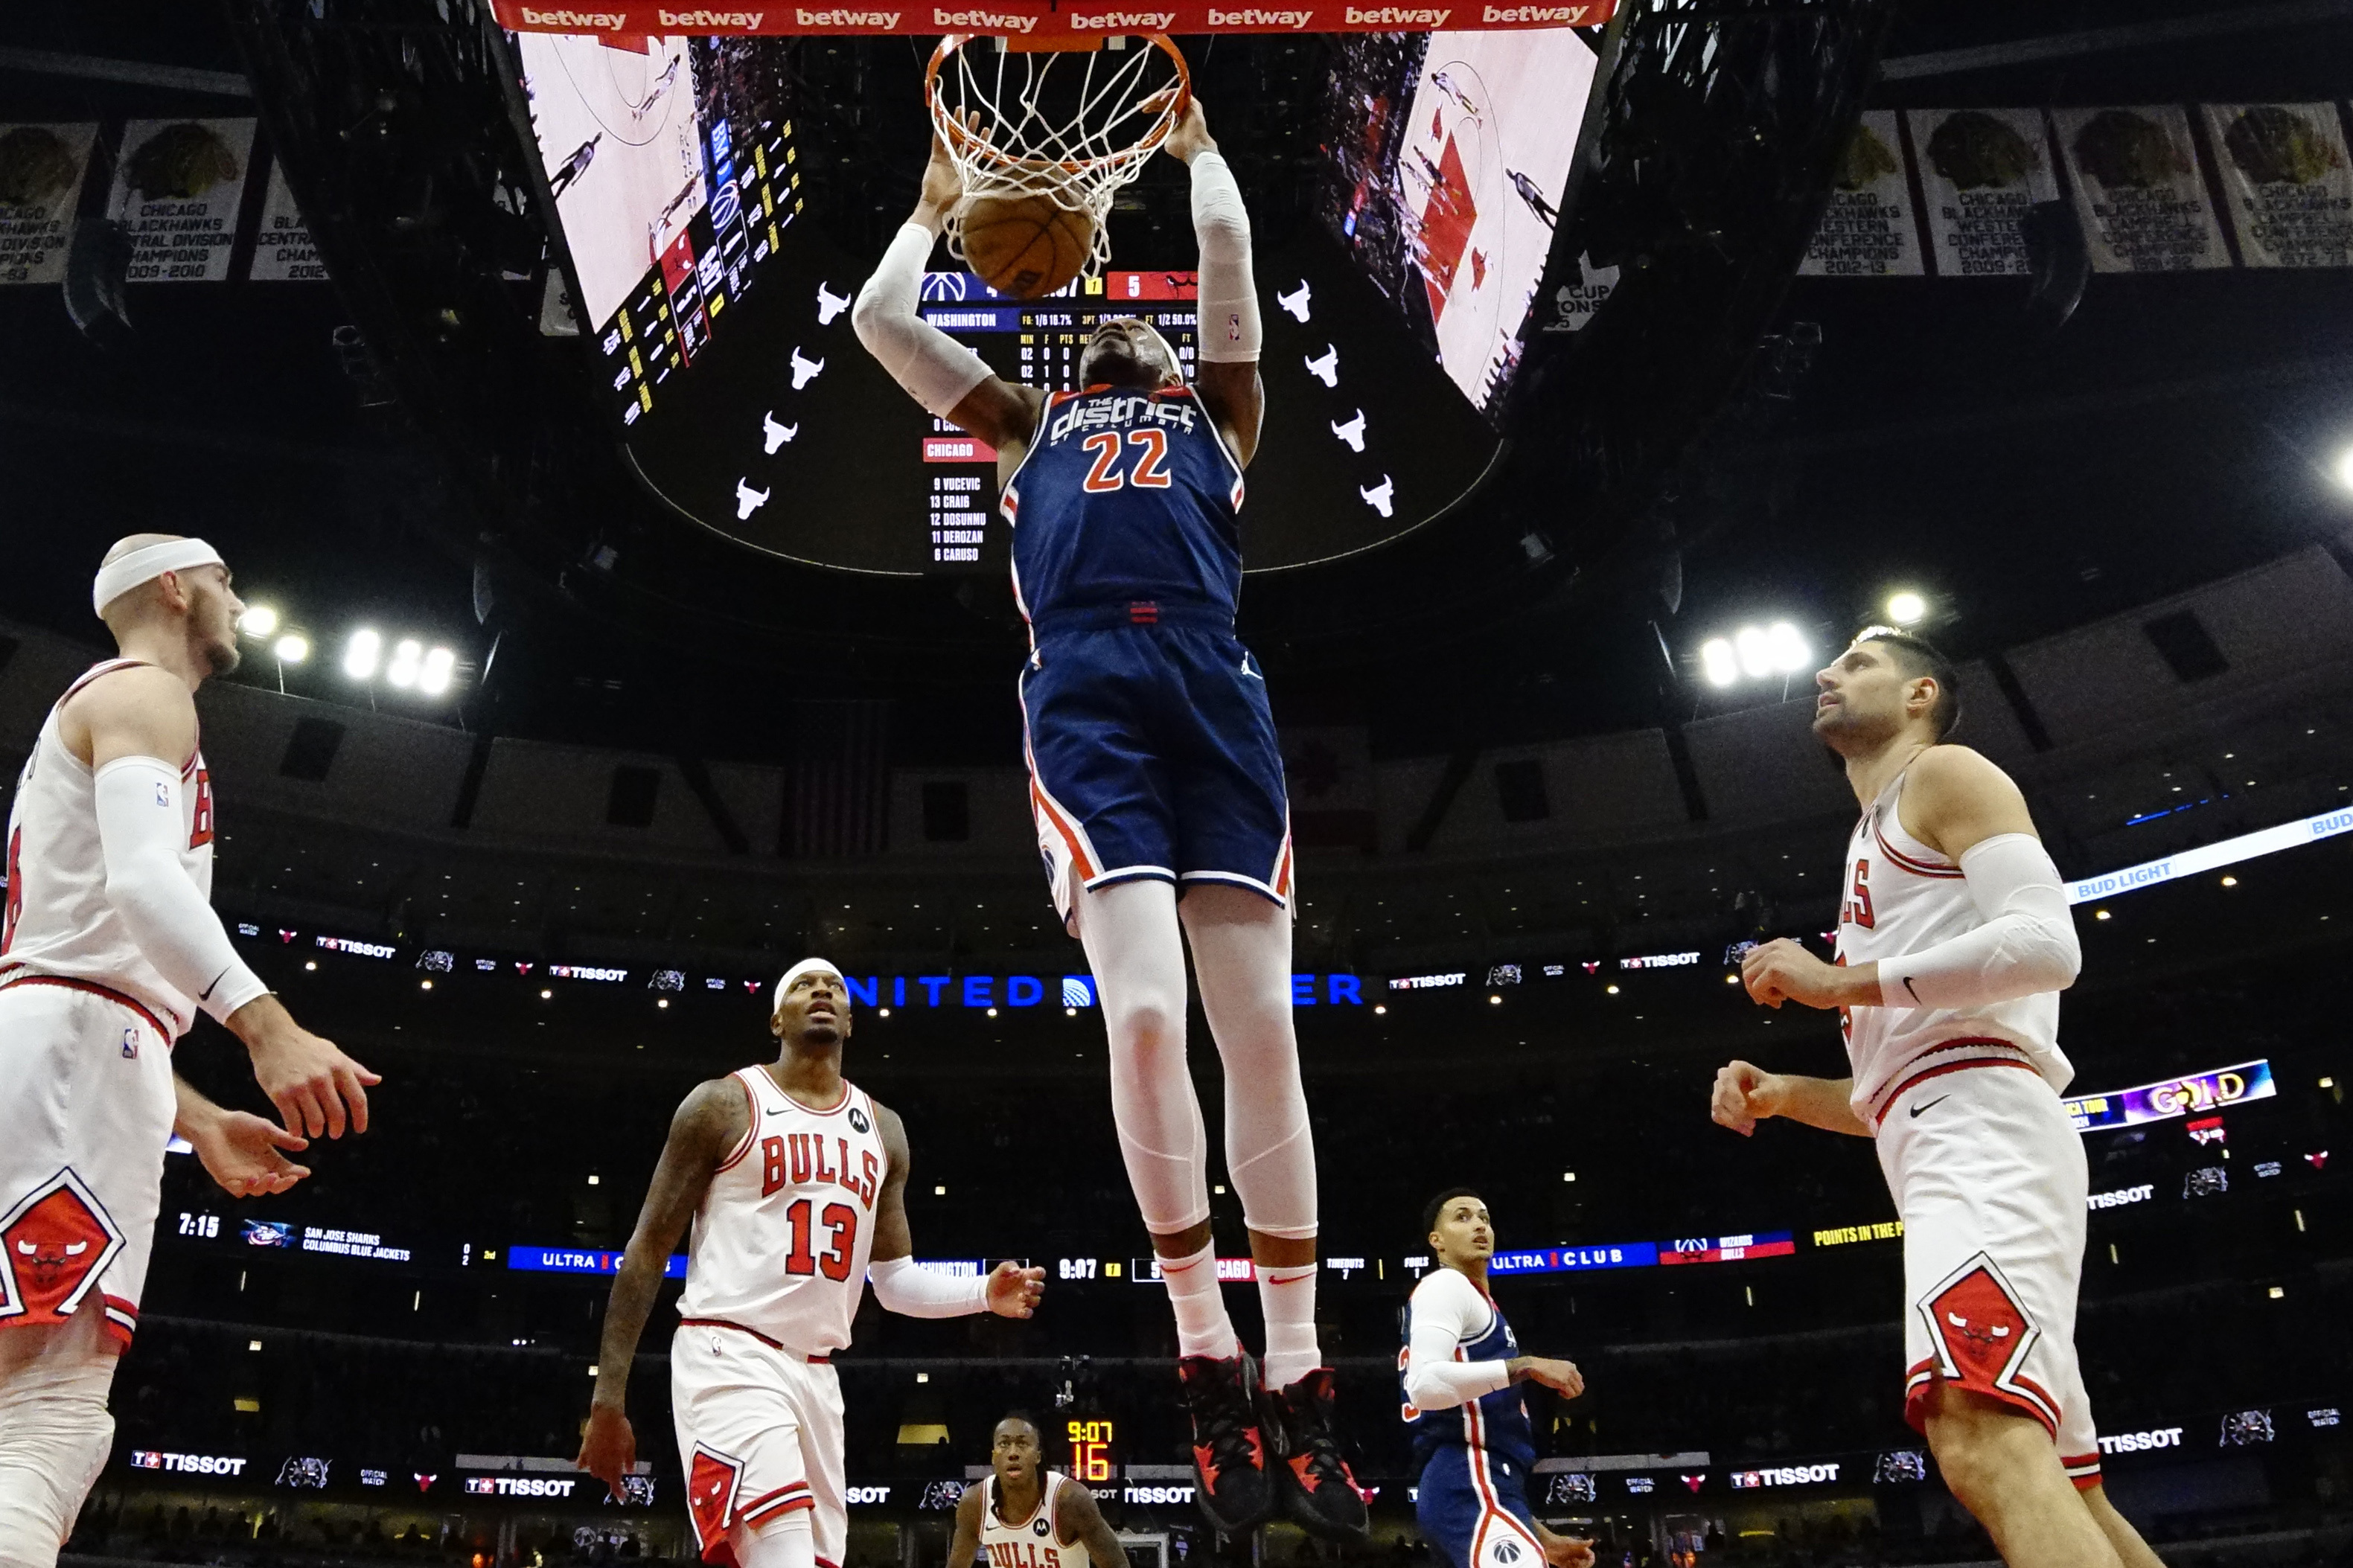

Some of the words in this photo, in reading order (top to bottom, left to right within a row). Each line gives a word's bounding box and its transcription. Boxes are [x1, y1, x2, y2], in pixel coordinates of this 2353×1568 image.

[522, 7, 625, 31] betway
[659, 9, 763, 29] betway
[796, 9, 901, 29] betway
[933, 8, 1038, 33] betway
[1071, 10, 1175, 30] betway
[1208, 8, 1313, 28] betway
[1345, 6, 1451, 27] betway
[1483, 4, 1589, 24] betway
[141, 204, 208, 217] CHICAGO
[1942, 206, 2025, 219] BLACKHAW
[1821, 220, 1889, 232] ESTERN
[1958, 220, 2017, 232] WESTE
[133, 234, 173, 246] TRAL
[175, 234, 234, 246] DIVISION
[724, 231, 742, 256] 4
[127, 265, 205, 278] 009-2010
[698, 245, 722, 295] 9:07
[1092, 281, 1097, 292] 1
[1128, 275, 1140, 298] 5
[1568, 284, 1609, 298] CUP
[677, 284, 697, 313] 5
[927, 314, 996, 327] WASHINGTON
[1035, 314, 1048, 327] 1/6
[1050, 314, 1072, 326] 16.7%
[1158, 314, 1171, 326] 1/2
[1172, 314, 1197, 326] 50.0%
[1021, 335, 1034, 344] MIN
[1044, 335, 1049, 344] F
[1060, 335, 1073, 344] PTS
[1182, 333, 1190, 342] FT
[1021, 348, 1033, 360] 02
[1044, 348, 1050, 360] 0
[1063, 348, 1070, 360] 0
[1021, 365, 1033, 378] 02
[1044, 365, 1049, 378] 1
[1063, 365, 1070, 378] 0
[1088, 397, 1113, 407] THE
[1050, 397, 1196, 441] district
[928, 444, 974, 456] CHICAGO
[1083, 428, 1172, 493] 22
[934, 478, 940, 490] 9
[943, 478, 980, 490] VUCEVIC
[930, 495, 940, 508] 13
[943, 495, 970, 508] CRAIG
[930, 513, 940, 525] 12
[943, 513, 986, 525] DOSUNMU
[932, 531, 940, 543] 11
[943, 531, 983, 543] DEROZAN
[934, 548, 941, 561] 6
[943, 548, 979, 561] CARUSO
[2078, 878, 2116, 897] BUD
[2119, 862, 2172, 889] LIGHT
[339, 939, 395, 959] TISSOT
[1641, 953, 1700, 968] TISSOT
[571, 966, 628, 982] TISSOT
[1410, 973, 1465, 989] TISSOT
[844, 976, 1044, 1007] NITED
[762, 1133, 878, 1212] BULLS
[2086, 1184, 2154, 1210] TISSOT
[179, 1212, 220, 1238] 7:15
[1814, 1226, 1856, 1246] POINTS
[1858, 1225, 1871, 1241] IN
[1871, 1222, 1896, 1239] THE
[305, 1226, 322, 1239] SAN
[323, 1229, 345, 1242] JOSE
[346, 1232, 380, 1246] SHARKS
[785, 1199, 857, 1283] 13
[303, 1238, 349, 1255] COLUMBUS
[351, 1244, 372, 1257] BLUE
[373, 1246, 410, 1261] JACKETS
[464, 1244, 470, 1255] 0
[1720, 1247, 1744, 1260] BULLS
[462, 1255, 468, 1265] 2
[543, 1252, 595, 1268] ULTRA
[1327, 1258, 1364, 1268] TIMEOUTS
[1404, 1256, 1429, 1267] FOULS
[1492, 1254, 1545, 1270] ULTRA
[1565, 1249, 1623, 1264] CLUB
[1059, 1259, 1096, 1279] 9:07
[1110, 1265, 1115, 1276] 1
[1151, 1261, 1160, 1279] 5
[1217, 1261, 1251, 1279] CAGO
[1343, 1269, 1349, 1280] 7
[1414, 1267, 1420, 1279] 1
[1068, 1421, 1112, 1442] 9:07
[2098, 1427, 2183, 1453] TISSOT
[162, 1453, 246, 1475] TISSOT
[1075, 1444, 1108, 1481] 16
[360, 1469, 387, 1479] OFFICIAL
[1759, 1464, 1839, 1486] TISSOT
[496, 1478, 575, 1497] TISSOT
[847, 1487, 890, 1503] SOT
[1125, 1487, 1195, 1503] TISSOT
